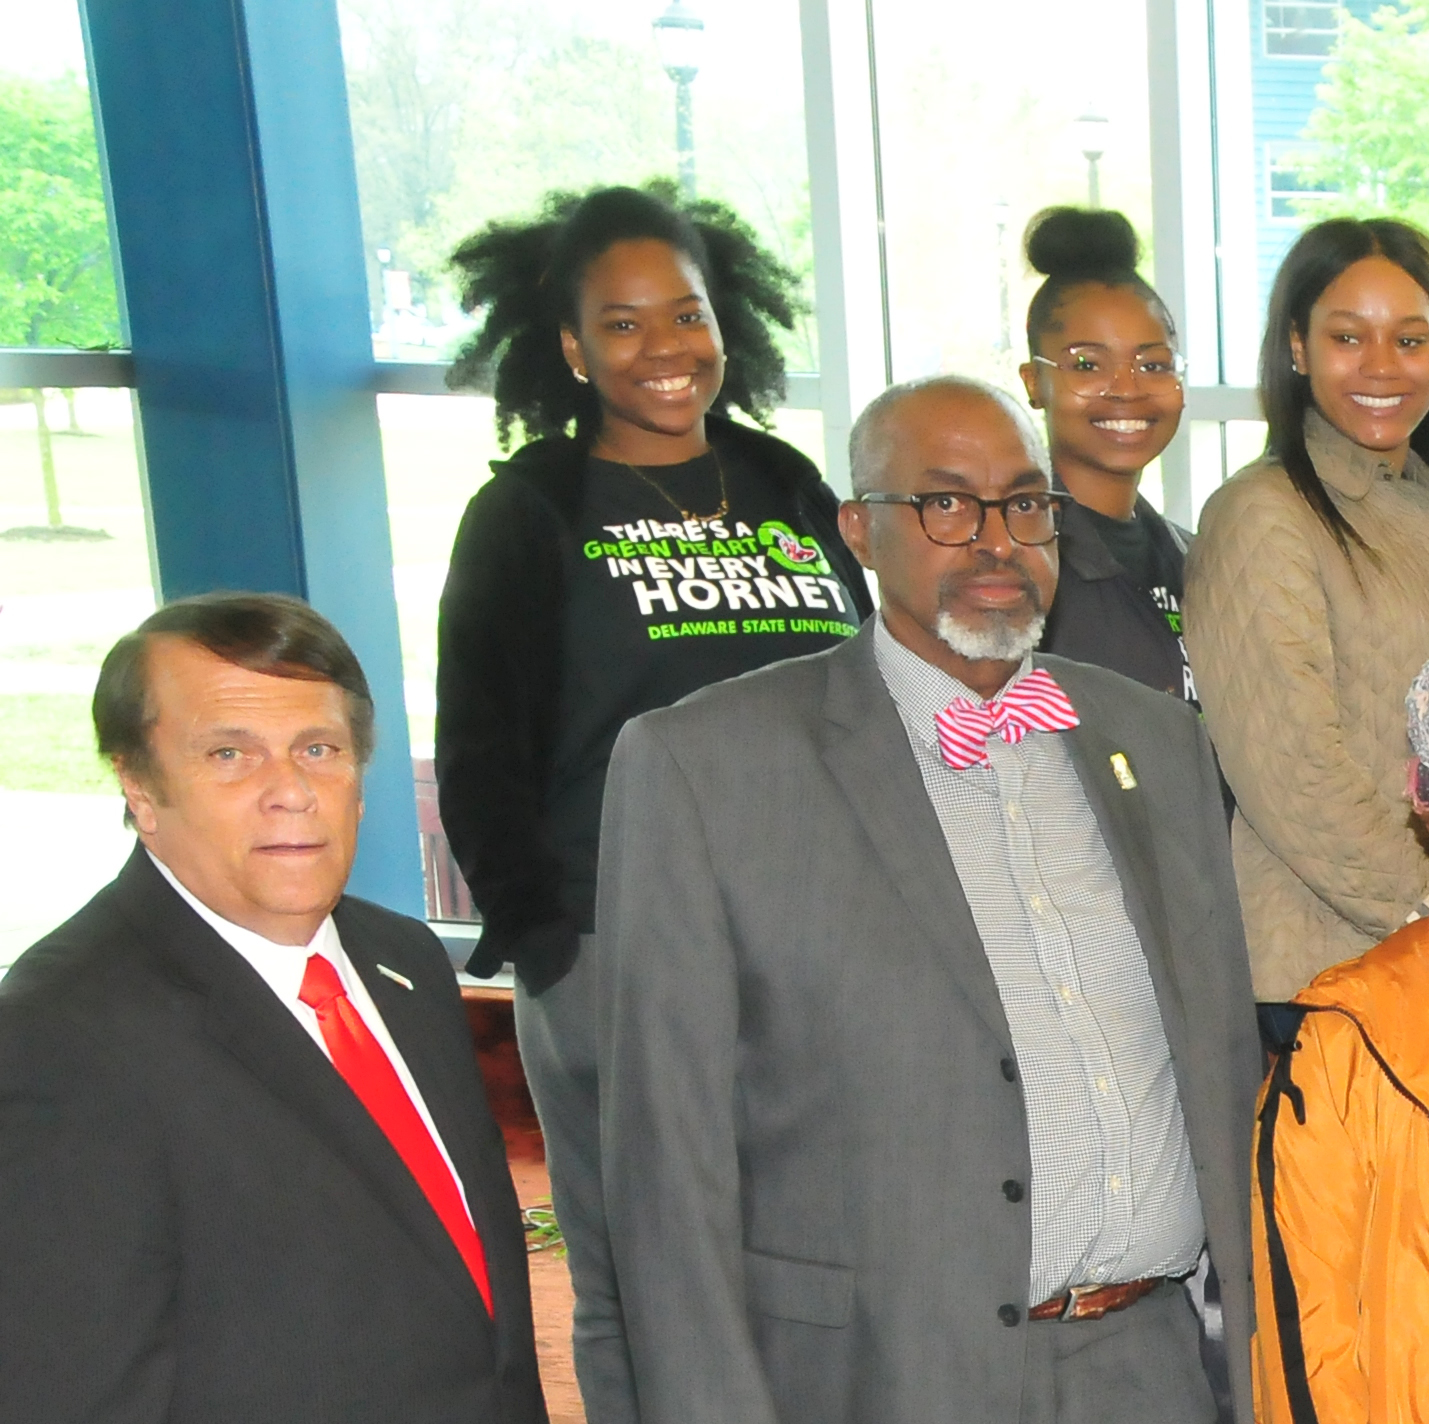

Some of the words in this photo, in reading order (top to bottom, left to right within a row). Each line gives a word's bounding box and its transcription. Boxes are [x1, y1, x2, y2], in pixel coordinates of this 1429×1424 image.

[602, 518, 730, 543] THERE'S
[735, 521, 753, 538] A
[583, 539, 672, 560] GREEN
[677, 537, 760, 556] HEART
[607, 556, 643, 578] IN
[644, 555, 769, 580] EVERY
[632, 575, 847, 616] HORNET
[647, 621, 737, 640] DELAWARE
[742, 619, 786, 634] STATE
